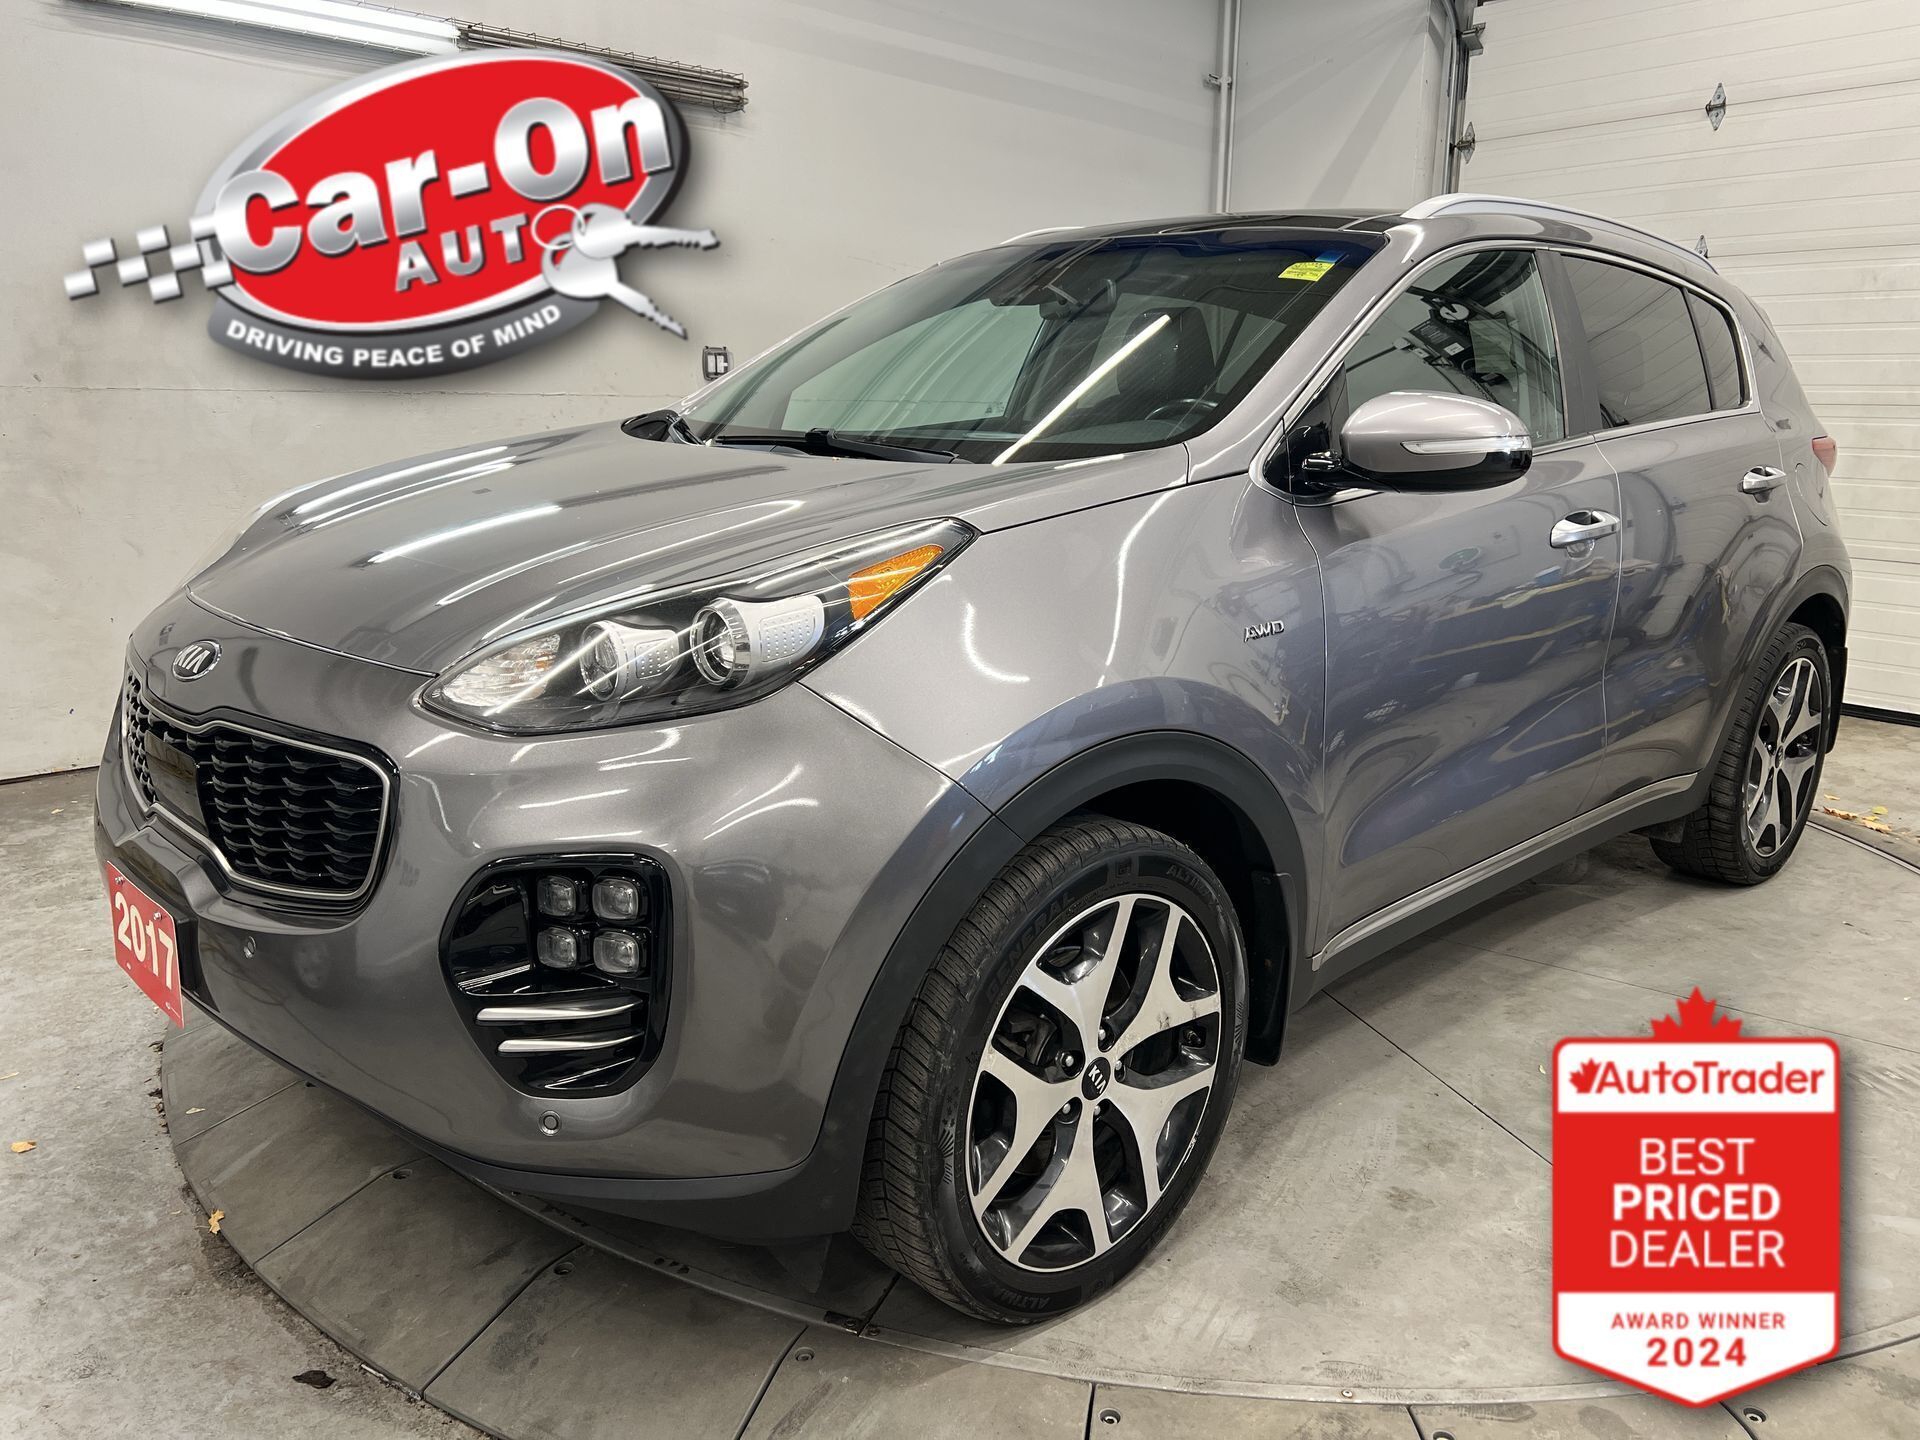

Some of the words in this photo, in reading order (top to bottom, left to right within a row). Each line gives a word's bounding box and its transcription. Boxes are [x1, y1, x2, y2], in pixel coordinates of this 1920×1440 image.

[1243, 620, 1285, 643] AWD
[175, 644, 211, 674] KIA
[115, 891, 174, 990] 2017
[1088, 1064, 1107, 1094] KIA
